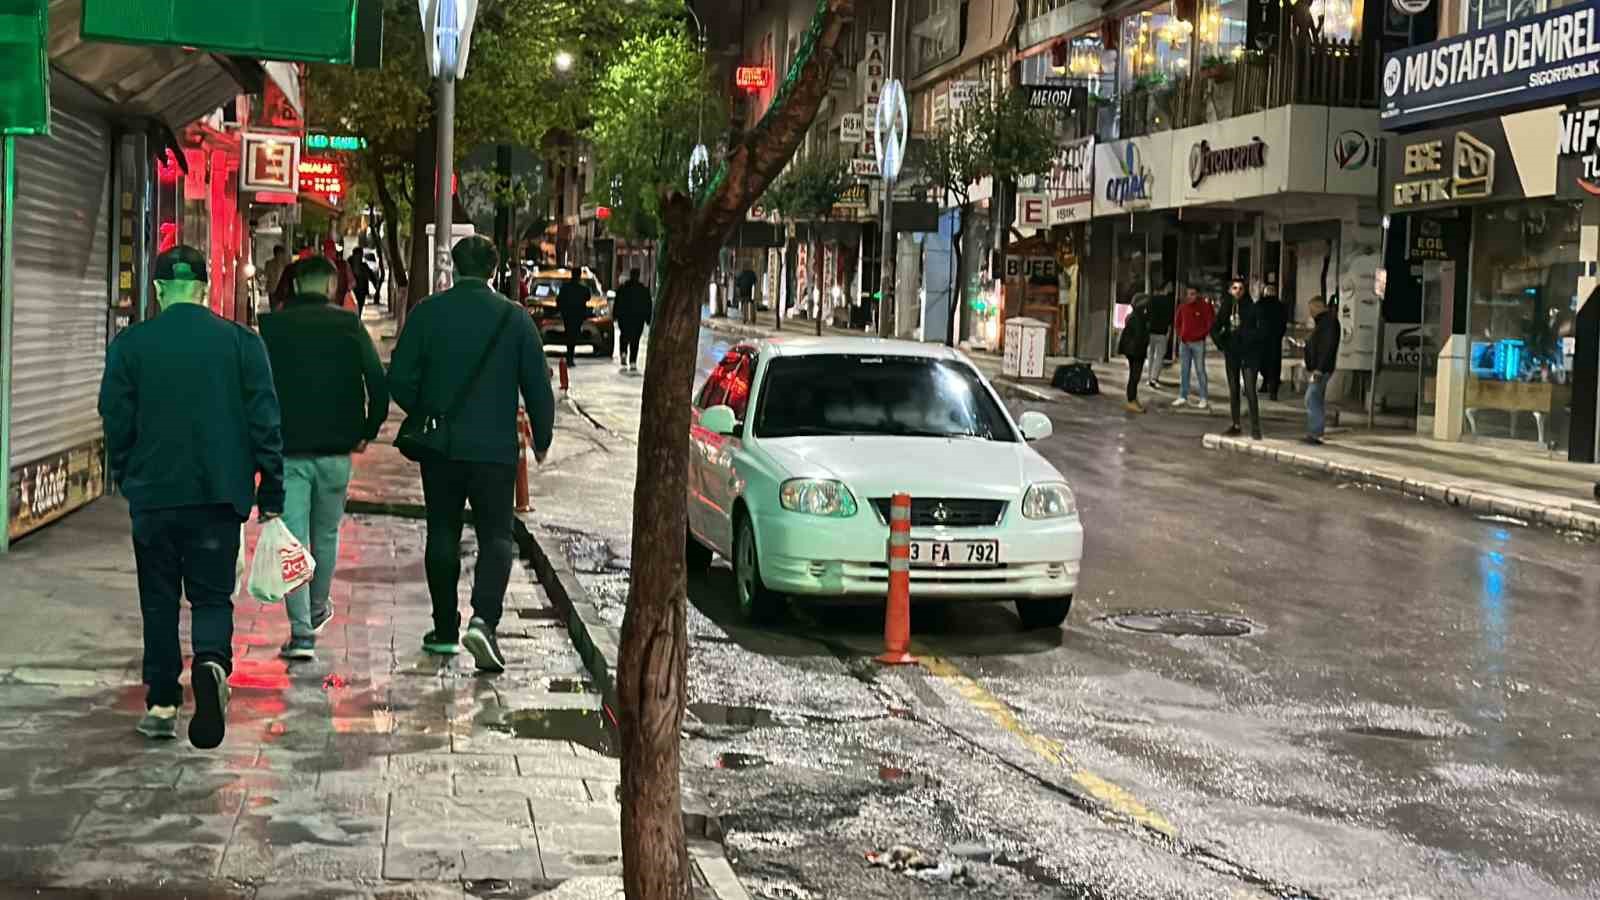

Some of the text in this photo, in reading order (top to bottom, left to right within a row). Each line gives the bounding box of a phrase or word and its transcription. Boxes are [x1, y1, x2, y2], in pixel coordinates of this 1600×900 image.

[1403, 33, 1498, 96] MUSTAFA
[1025, 199, 1042, 223] E
[1388, 351, 1427, 366] LACO
[910, 543, 994, 562] 3 FA 792
